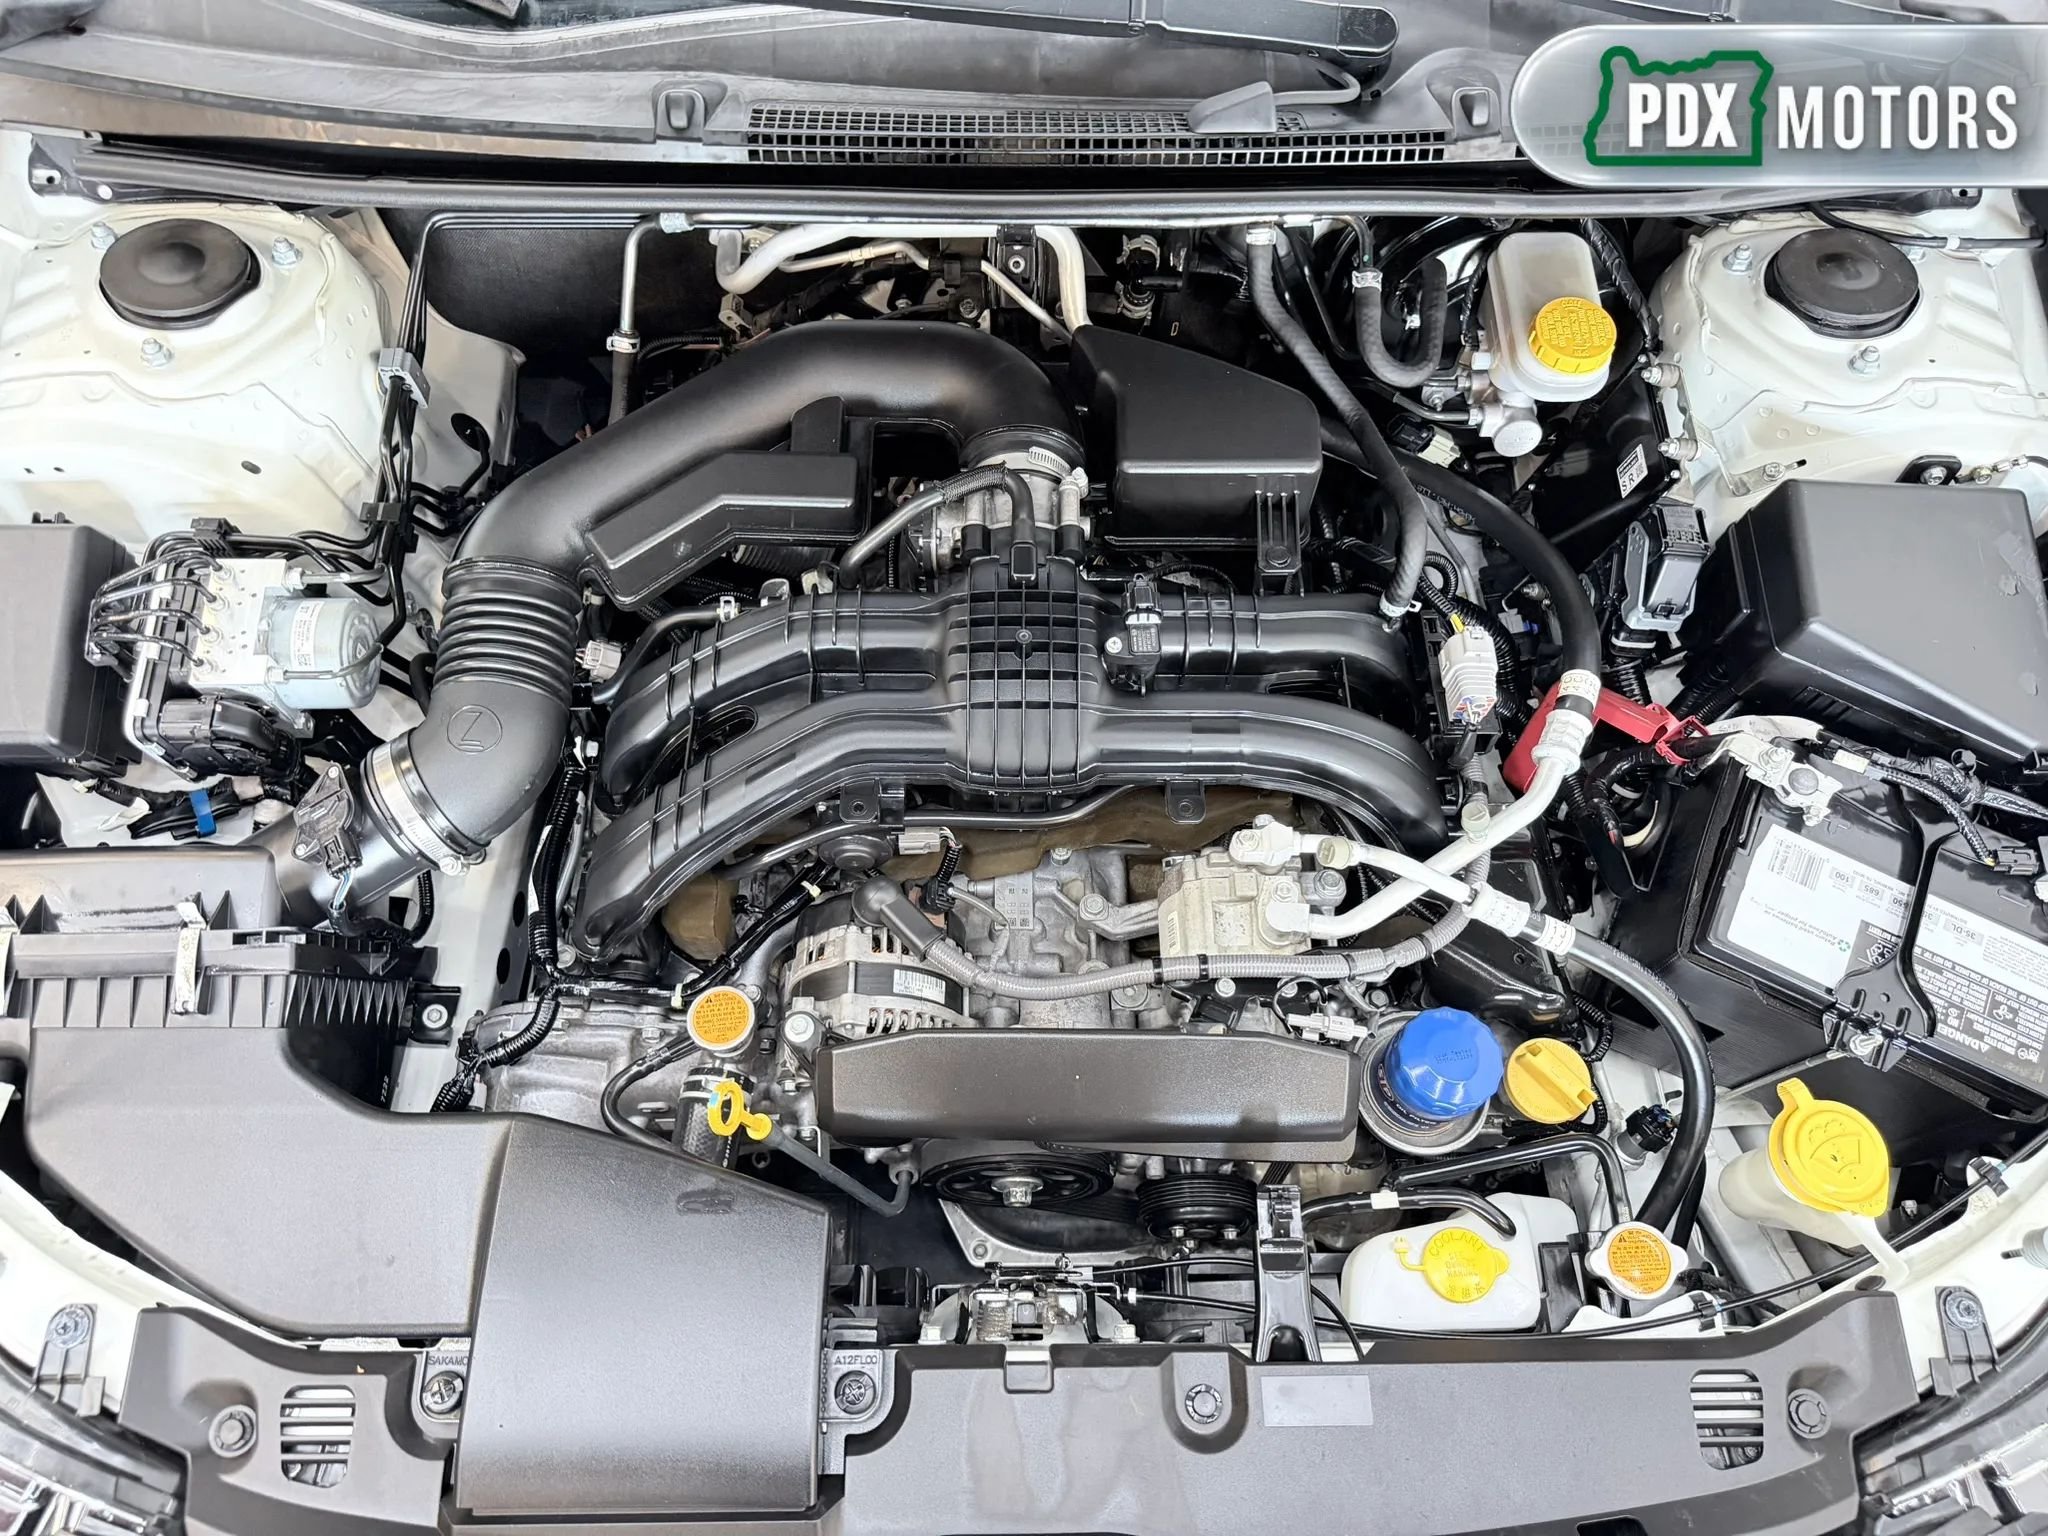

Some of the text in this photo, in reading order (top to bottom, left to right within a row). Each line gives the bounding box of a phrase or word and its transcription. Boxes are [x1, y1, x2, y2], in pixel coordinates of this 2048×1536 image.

[1834, 870, 1849, 883] 100
[1863, 883, 1879, 897] 685
[1429, 1231, 1487, 1257] COOLANT
